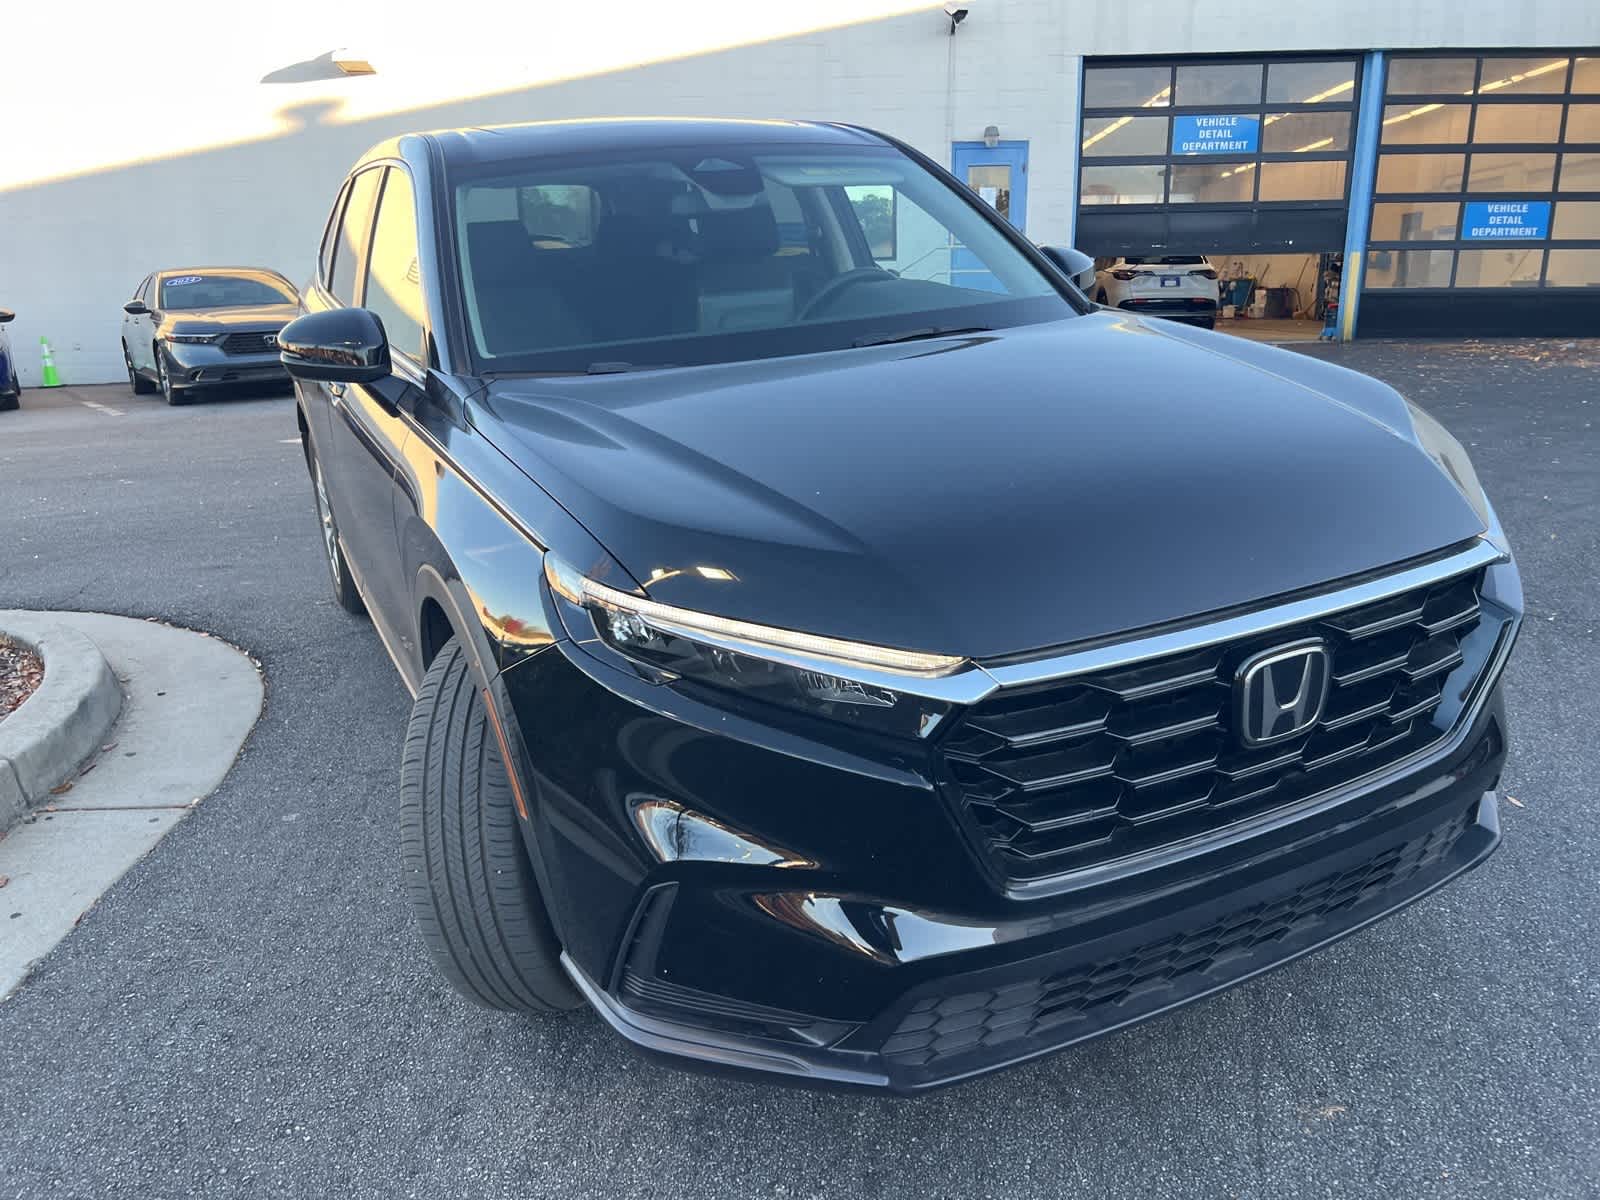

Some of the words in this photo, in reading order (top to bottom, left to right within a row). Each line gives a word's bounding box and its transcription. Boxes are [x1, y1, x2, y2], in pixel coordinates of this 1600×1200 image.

[1196, 117, 1238, 127] VEHICLE
[1199, 129, 1232, 139] DETAIL
[1182, 141, 1248, 151] DEPARTMENT
[1487, 203, 1528, 213] VEHICLE
[1488, 216, 1523, 225] DETAIL
[1471, 227, 1538, 237] DEPARTMENT
